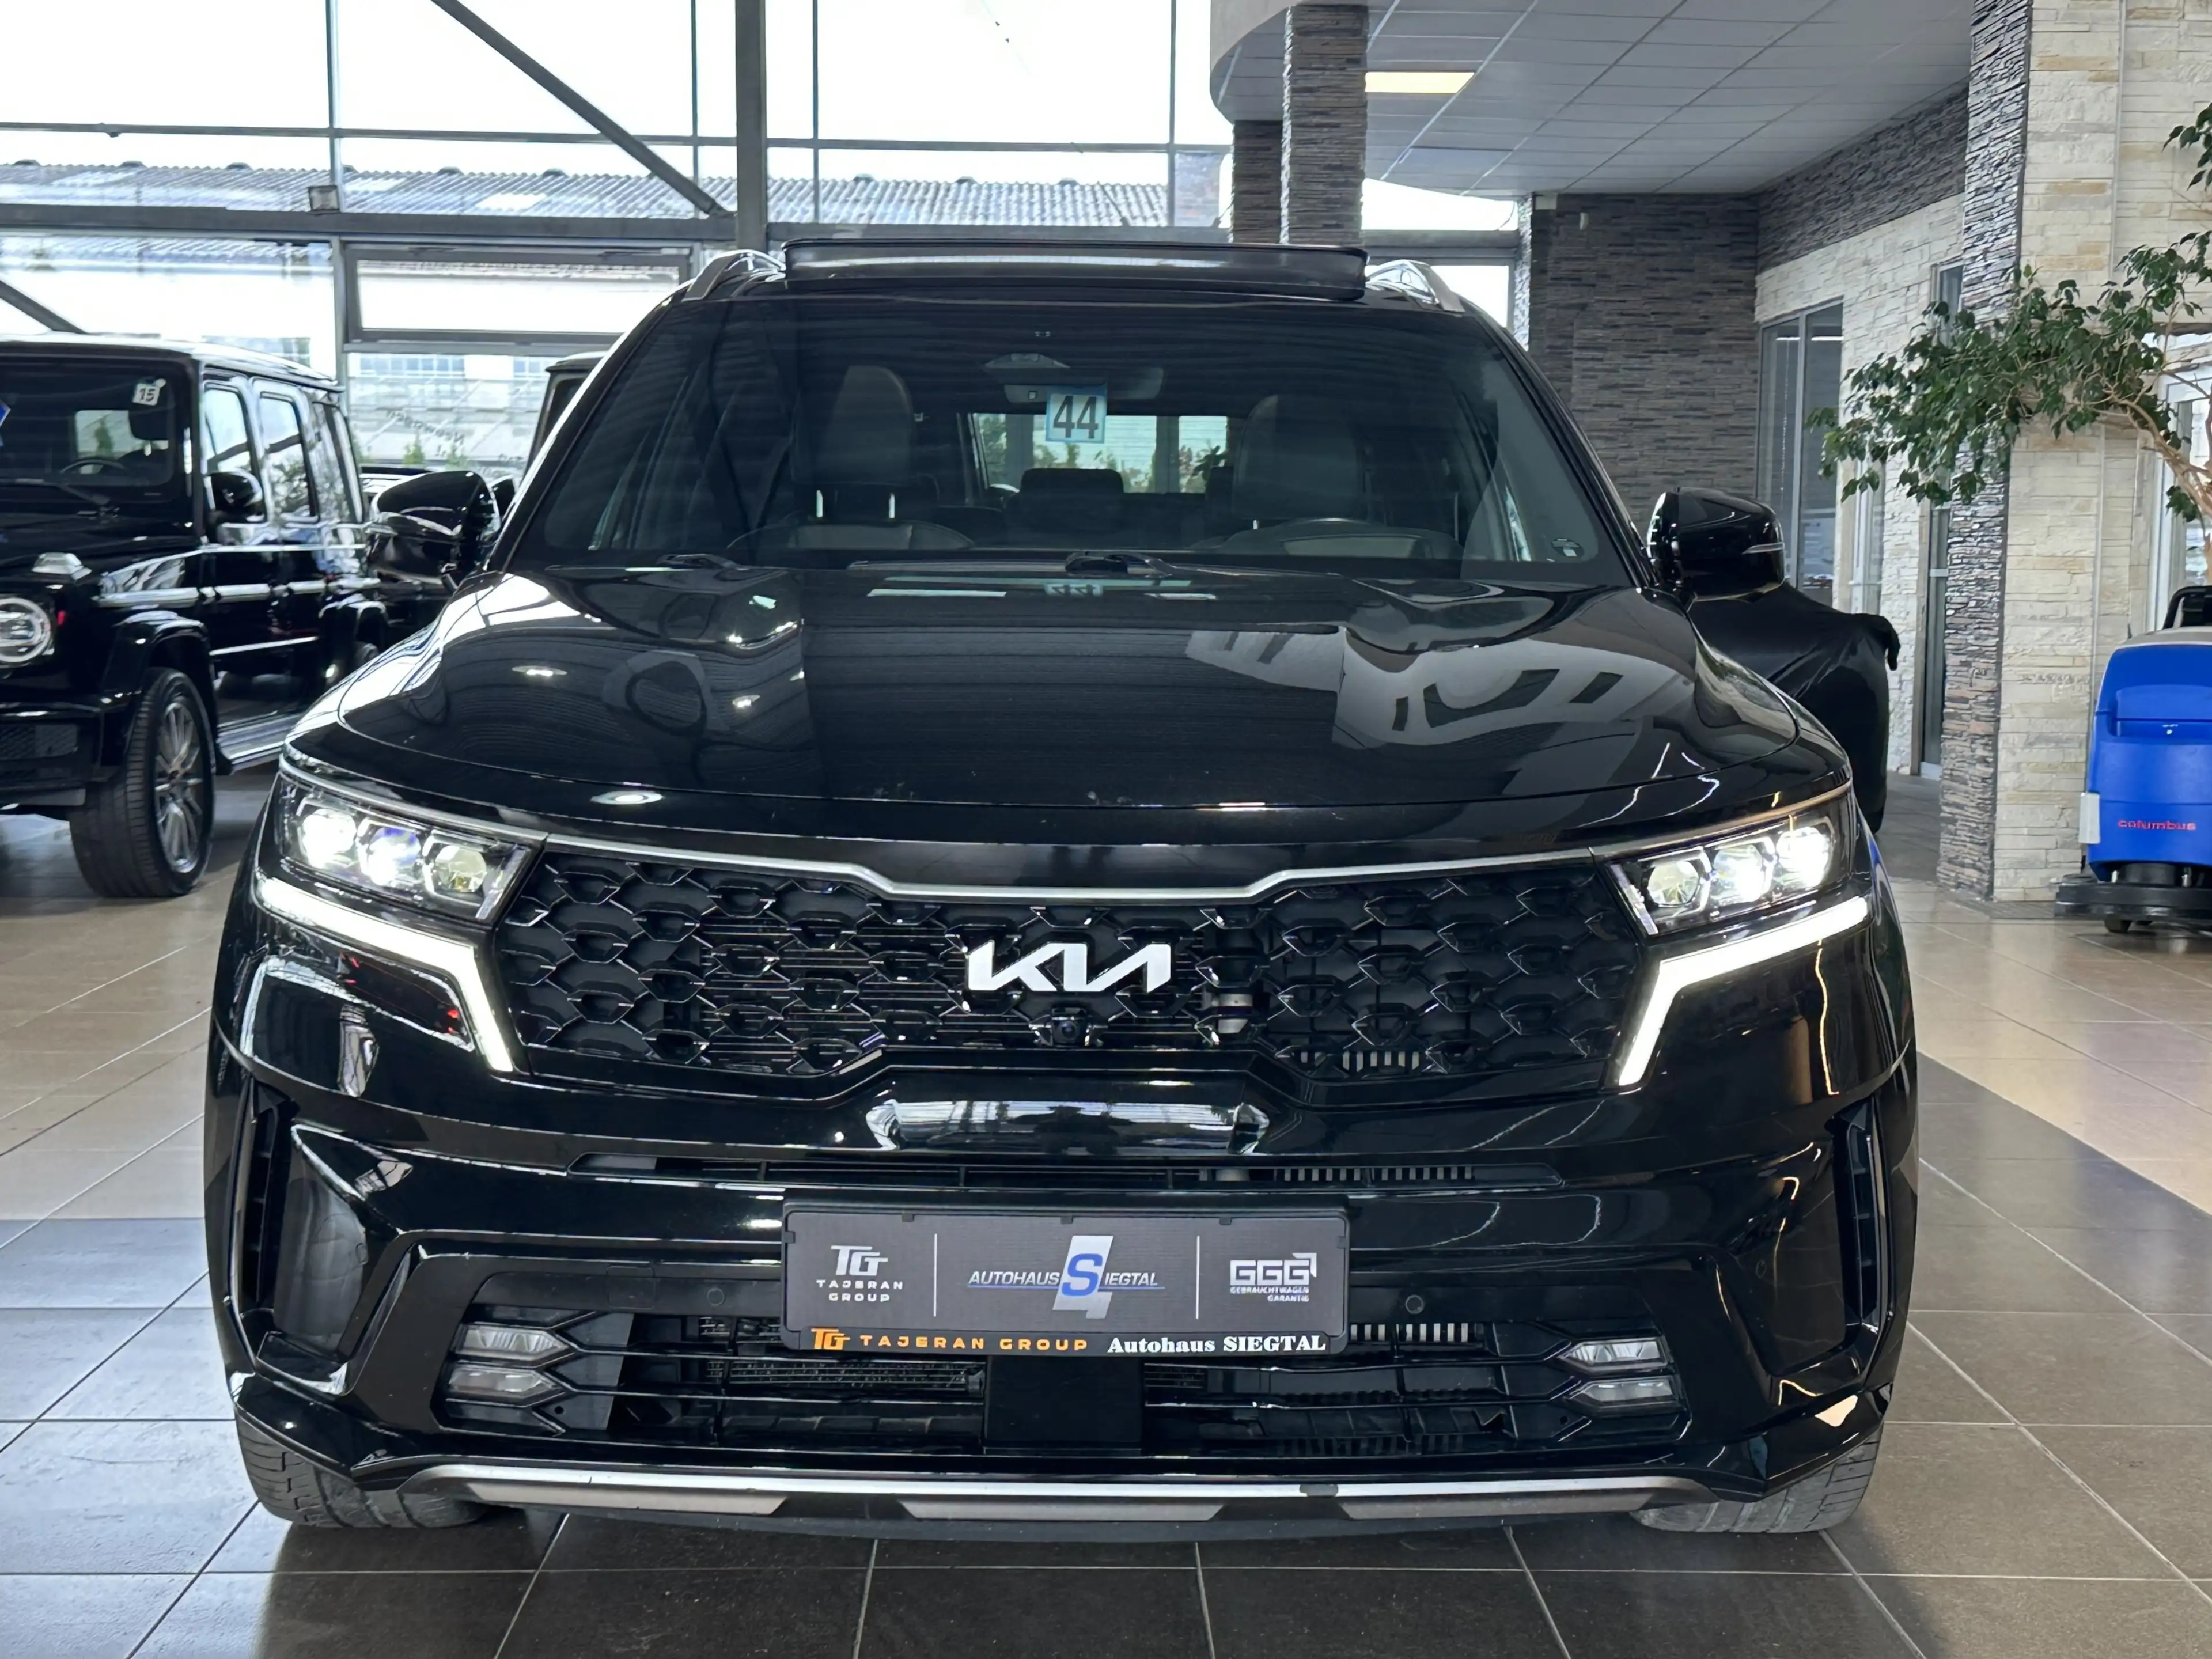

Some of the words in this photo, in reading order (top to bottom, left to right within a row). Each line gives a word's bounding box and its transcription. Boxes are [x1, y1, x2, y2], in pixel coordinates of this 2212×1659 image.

[139, 388, 156, 402] 15
[1053, 395, 1099, 440] 44
[2118, 820, 2196, 830] columbus
[968, 1271, 1060, 1285] AUTOHAUS
[1230, 1260, 1309, 1285] GGG
[828, 1293, 890, 1302] GROUP
[859, 1335, 984, 1349] TAJERAN
[999, 1338, 1088, 1351] GROUP
[1107, 1337, 1215, 1353] Autohaus
[1223, 1335, 1326, 1351] SIEGTAL
